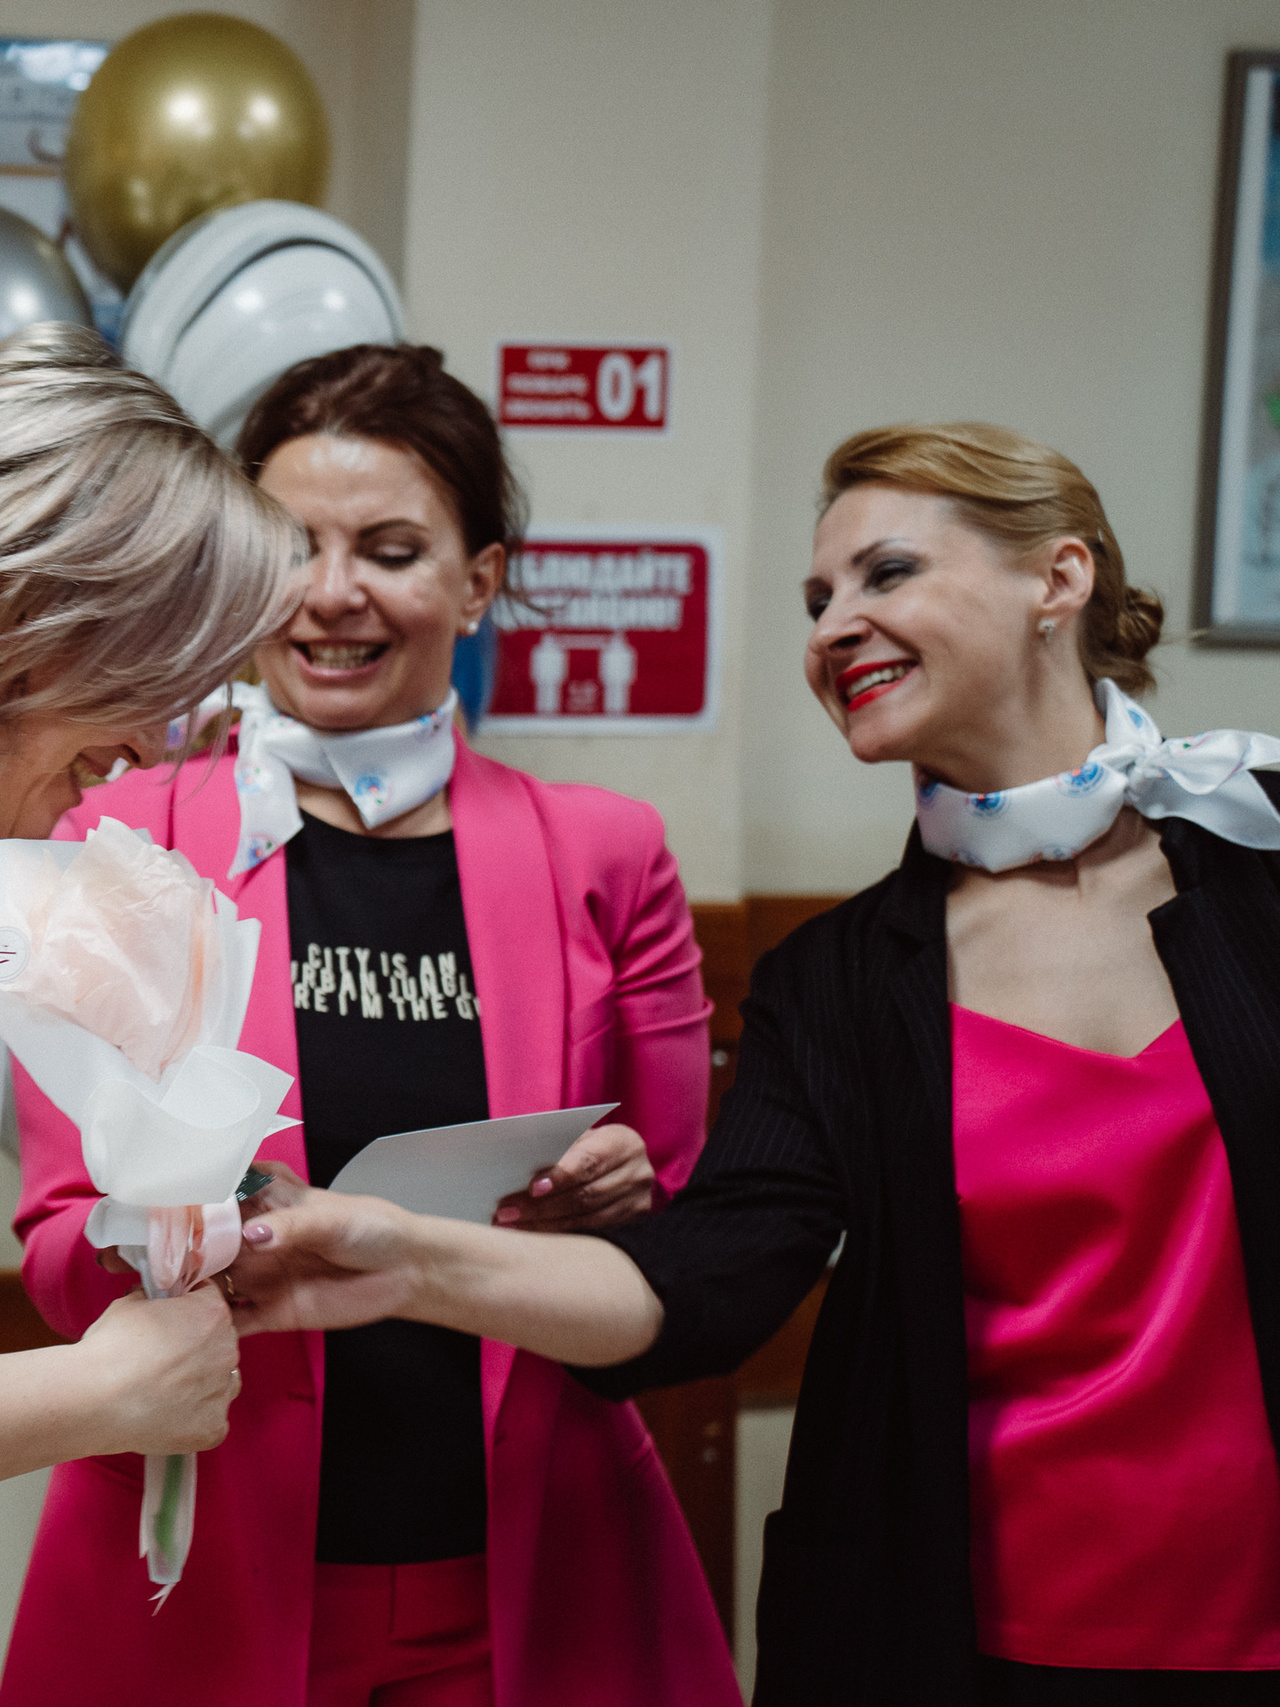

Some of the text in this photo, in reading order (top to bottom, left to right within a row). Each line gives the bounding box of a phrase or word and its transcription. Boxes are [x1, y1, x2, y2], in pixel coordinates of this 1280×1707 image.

[598, 352, 663, 422] 01
[308, 942, 457, 981] CITY IS AN
